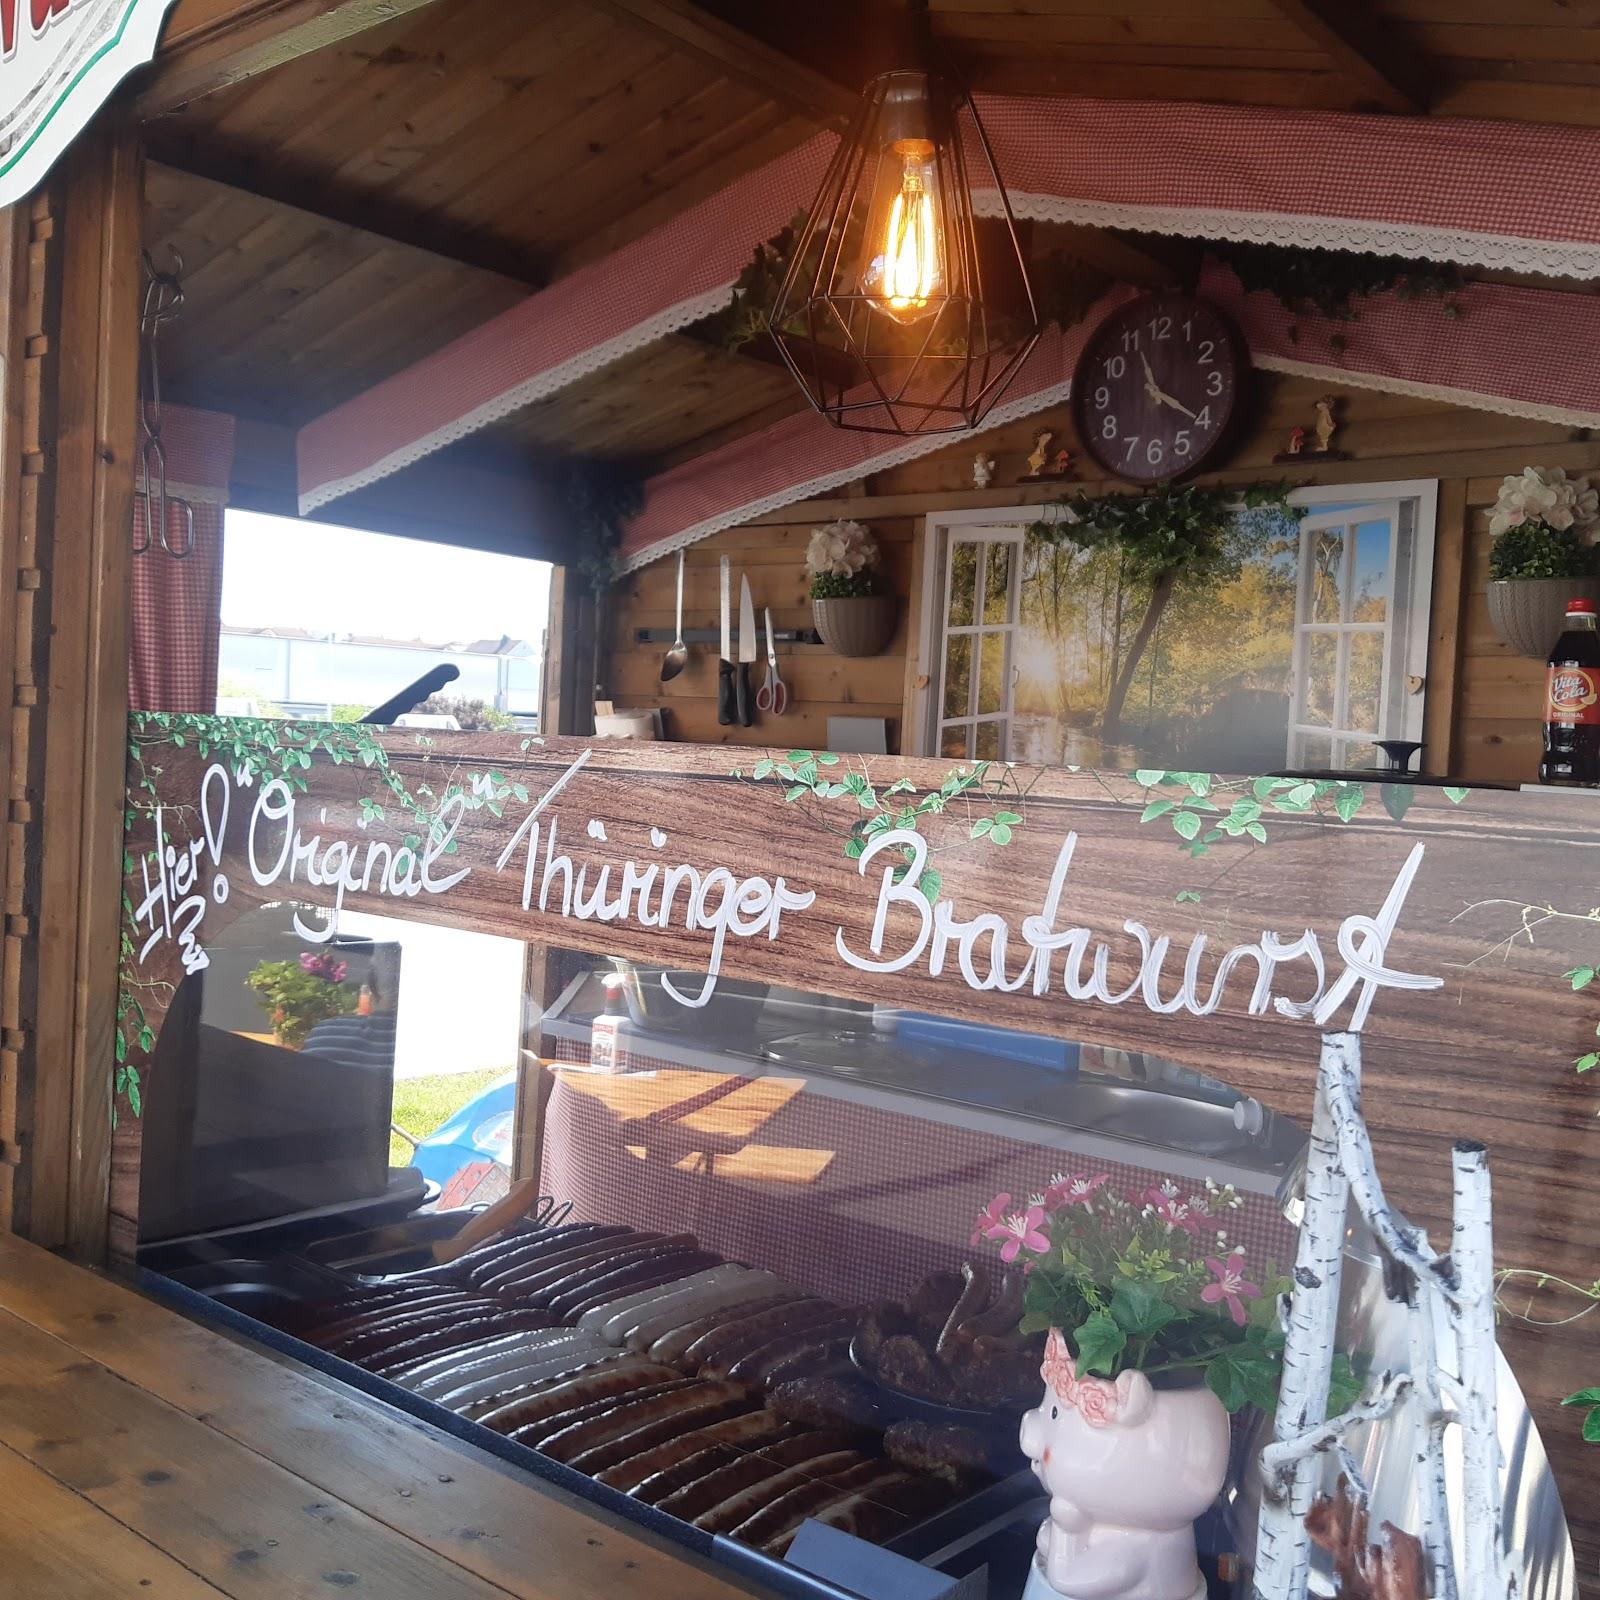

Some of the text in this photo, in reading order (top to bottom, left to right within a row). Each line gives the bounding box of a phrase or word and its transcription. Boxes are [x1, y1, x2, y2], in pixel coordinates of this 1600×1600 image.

[1148, 317, 1172, 340] 12
[1182, 320, 1192, 342] 1
[1121, 329, 1140, 352] 11
[1197, 341, 1214, 364] 2
[1103, 356, 1126, 379] 10
[1206, 371, 1223, 396] 3
[1095, 387, 1109, 409] 9
[1102, 415, 1117, 439] 8
[1194, 405, 1211, 430] 4
[1123, 437, 1139, 462] 7
[1146, 439, 1163, 464] 6
[1174, 430, 1191, 455] 5
[1552, 674, 1583, 690] Vita
[1552, 685, 1588, 702] Cola
[496, 748, 816, 1008] Thüringer
[835, 829, 1445, 1033] Bratwurst
